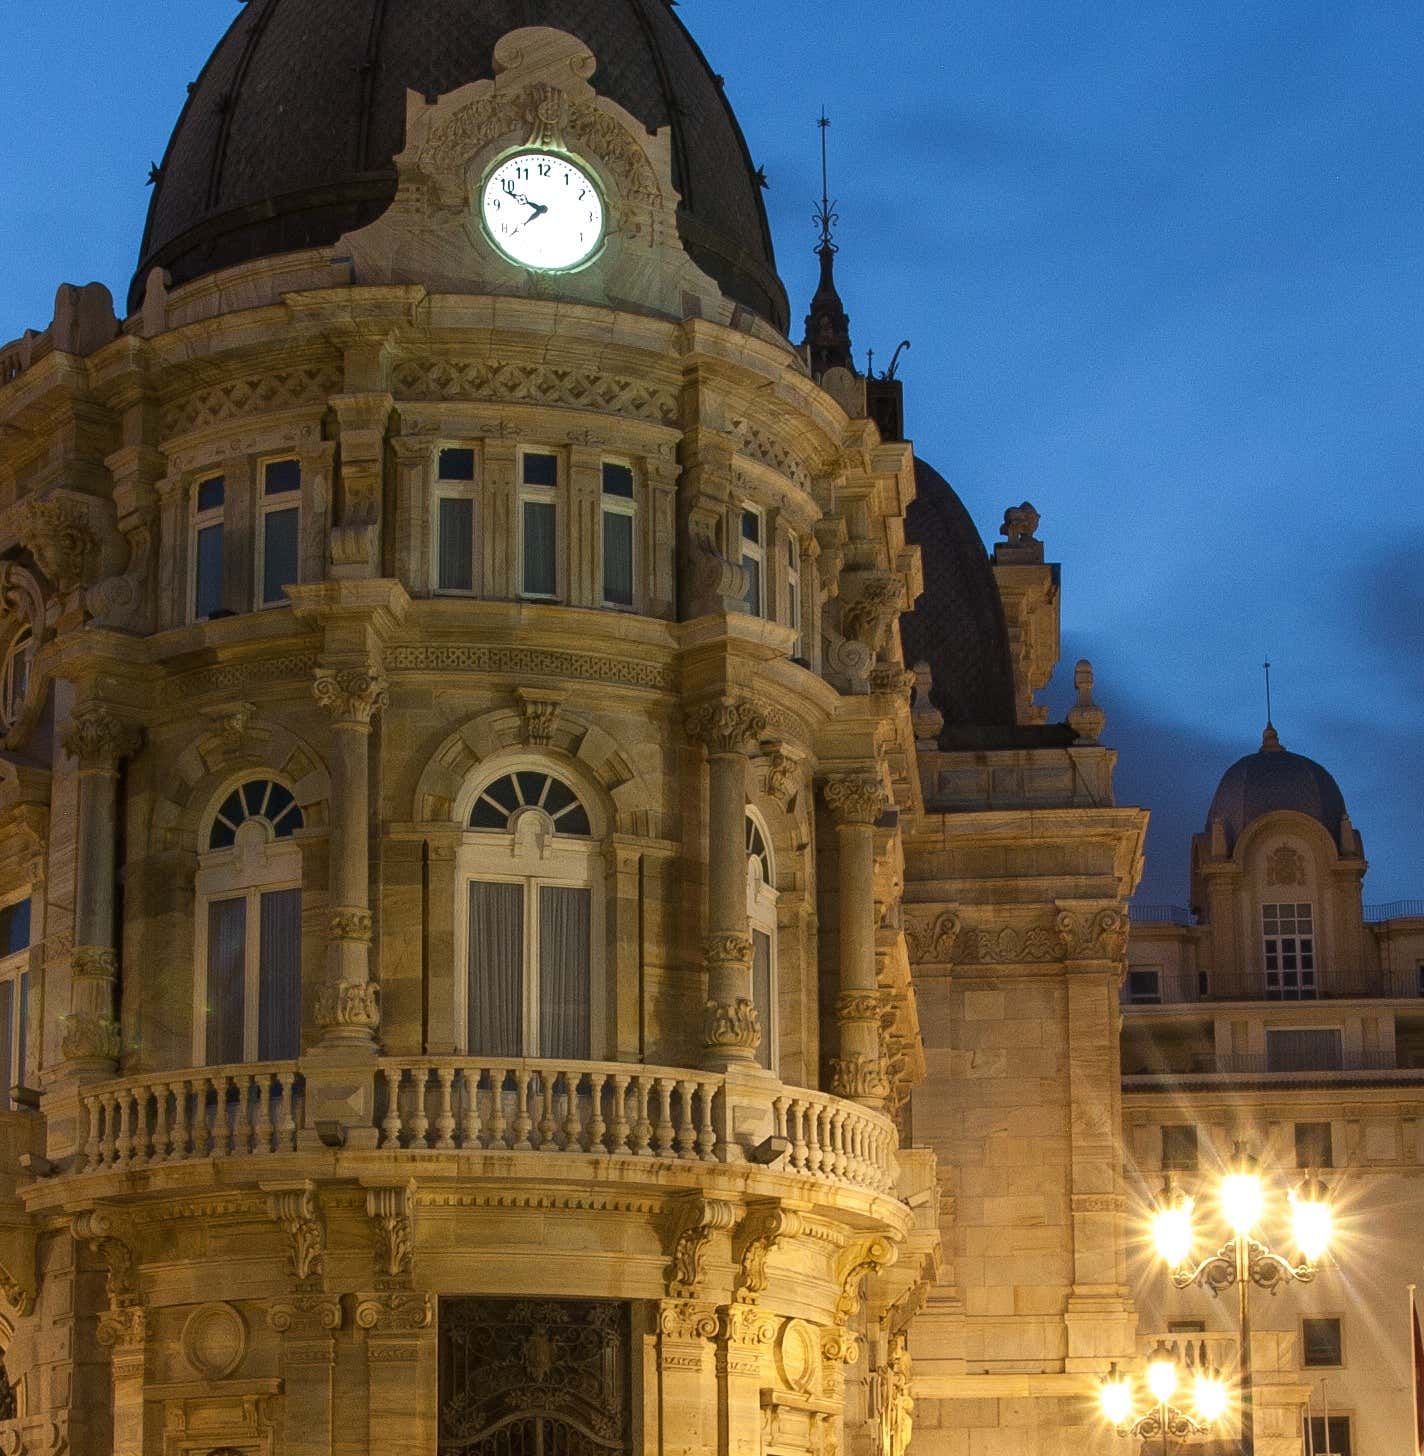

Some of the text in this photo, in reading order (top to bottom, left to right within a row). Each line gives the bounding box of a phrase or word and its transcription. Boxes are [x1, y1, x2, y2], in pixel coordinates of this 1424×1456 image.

[516, 167, 528, 180] 11
[537, 163, 551, 177] 12
[501, 178, 515, 192] 10
[564, 173, 569, 186] 1
[578, 188, 586, 201] 2
[493, 199, 500, 211] 9
